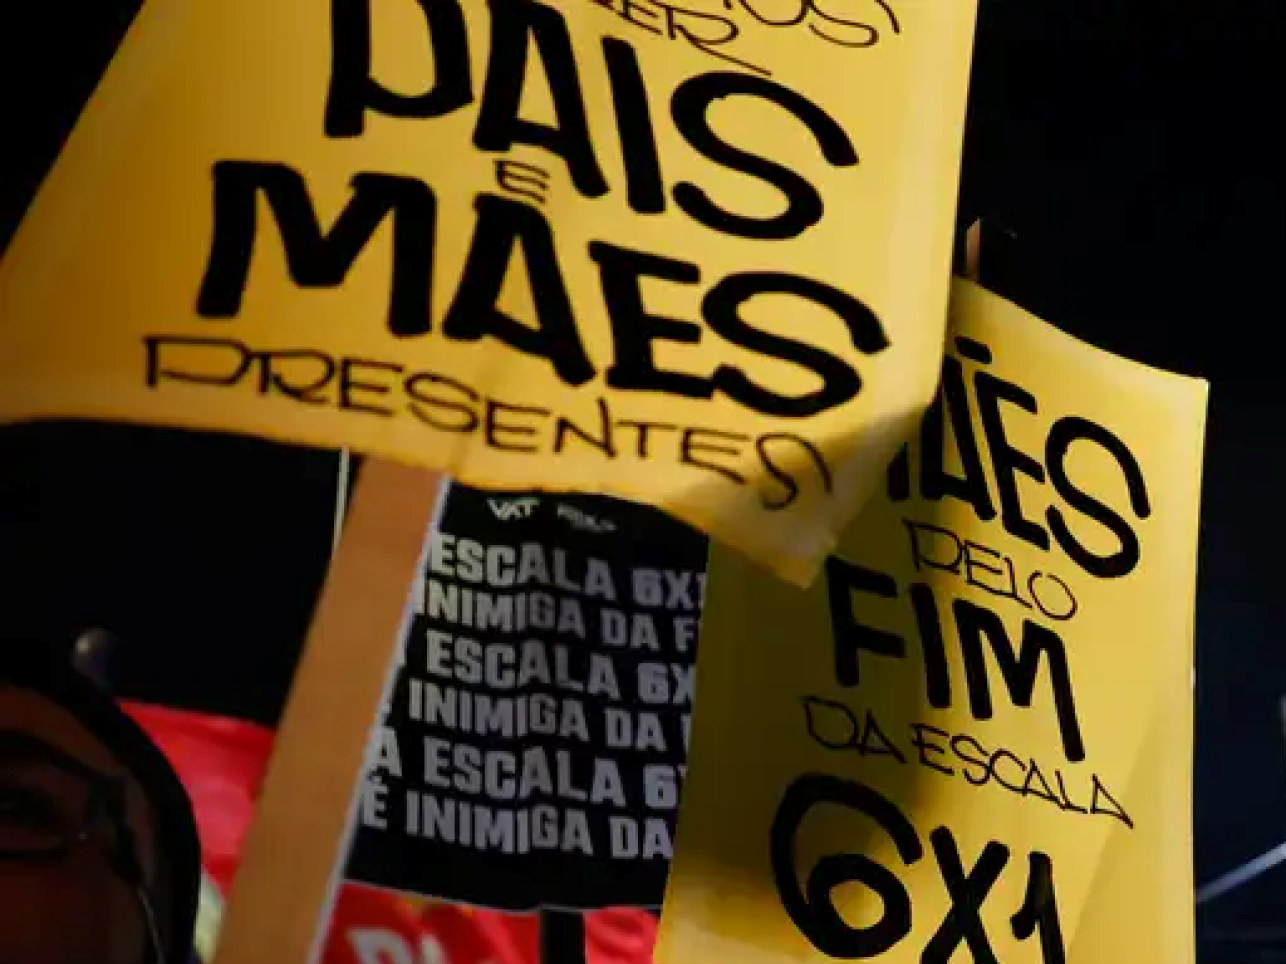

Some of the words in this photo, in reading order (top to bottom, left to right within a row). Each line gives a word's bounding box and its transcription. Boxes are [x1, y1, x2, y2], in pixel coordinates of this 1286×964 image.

[494, 159, 550, 205] E
[143, 335, 834, 511] PRESENTES
[887, 335, 1150, 579] ÃES
[428, 531, 619, 602] ESCALA
[902, 518, 1078, 621] PELO
[425, 627, 622, 702] ESCALA
[600, 607, 662, 654] DA
[826, 555, 1085, 762] FIM
[407, 676, 592, 745] INIMIGA
[603, 706, 669, 753] DA
[421, 735, 627, 810] ESCALA
[911, 722, 1134, 829] ESCALA
[402, 788, 595, 858] INIMIGA
[608, 815, 674, 861] DA
